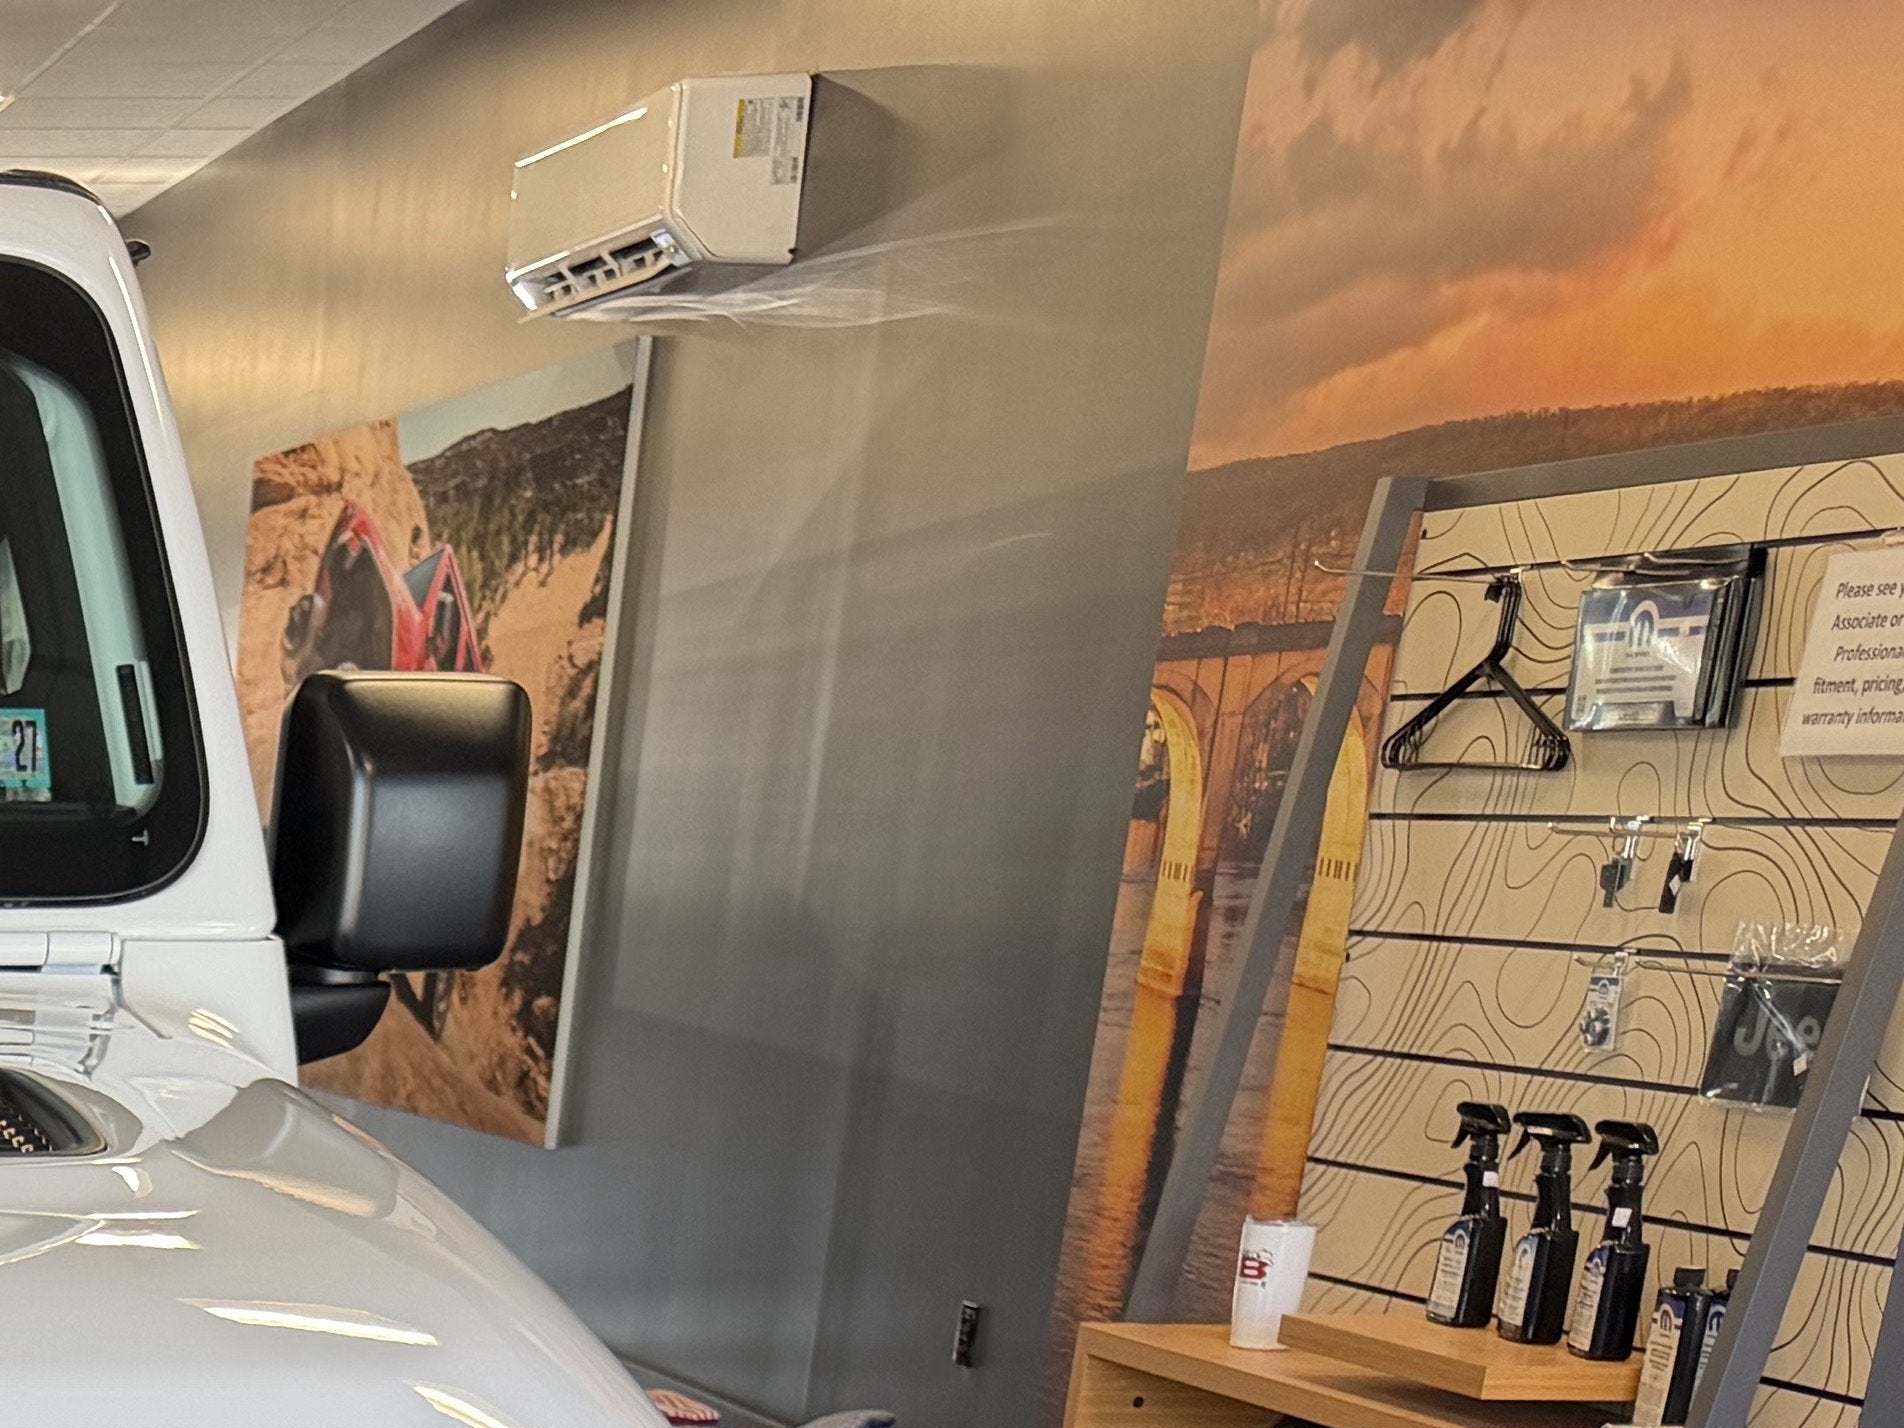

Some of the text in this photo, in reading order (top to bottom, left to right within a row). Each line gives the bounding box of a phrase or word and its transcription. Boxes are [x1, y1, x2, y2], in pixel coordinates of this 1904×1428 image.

[1835, 581, 1874, 600] Please
[1875, 582, 1897, 597] see
[1830, 612, 1904, 631] Associate or
[1812, 676, 1859, 696] fitment,
[1802, 710, 1854, 729] warranty
[11, 719, 38, 773] 27
[1733, 1000, 1822, 1062] Jee
